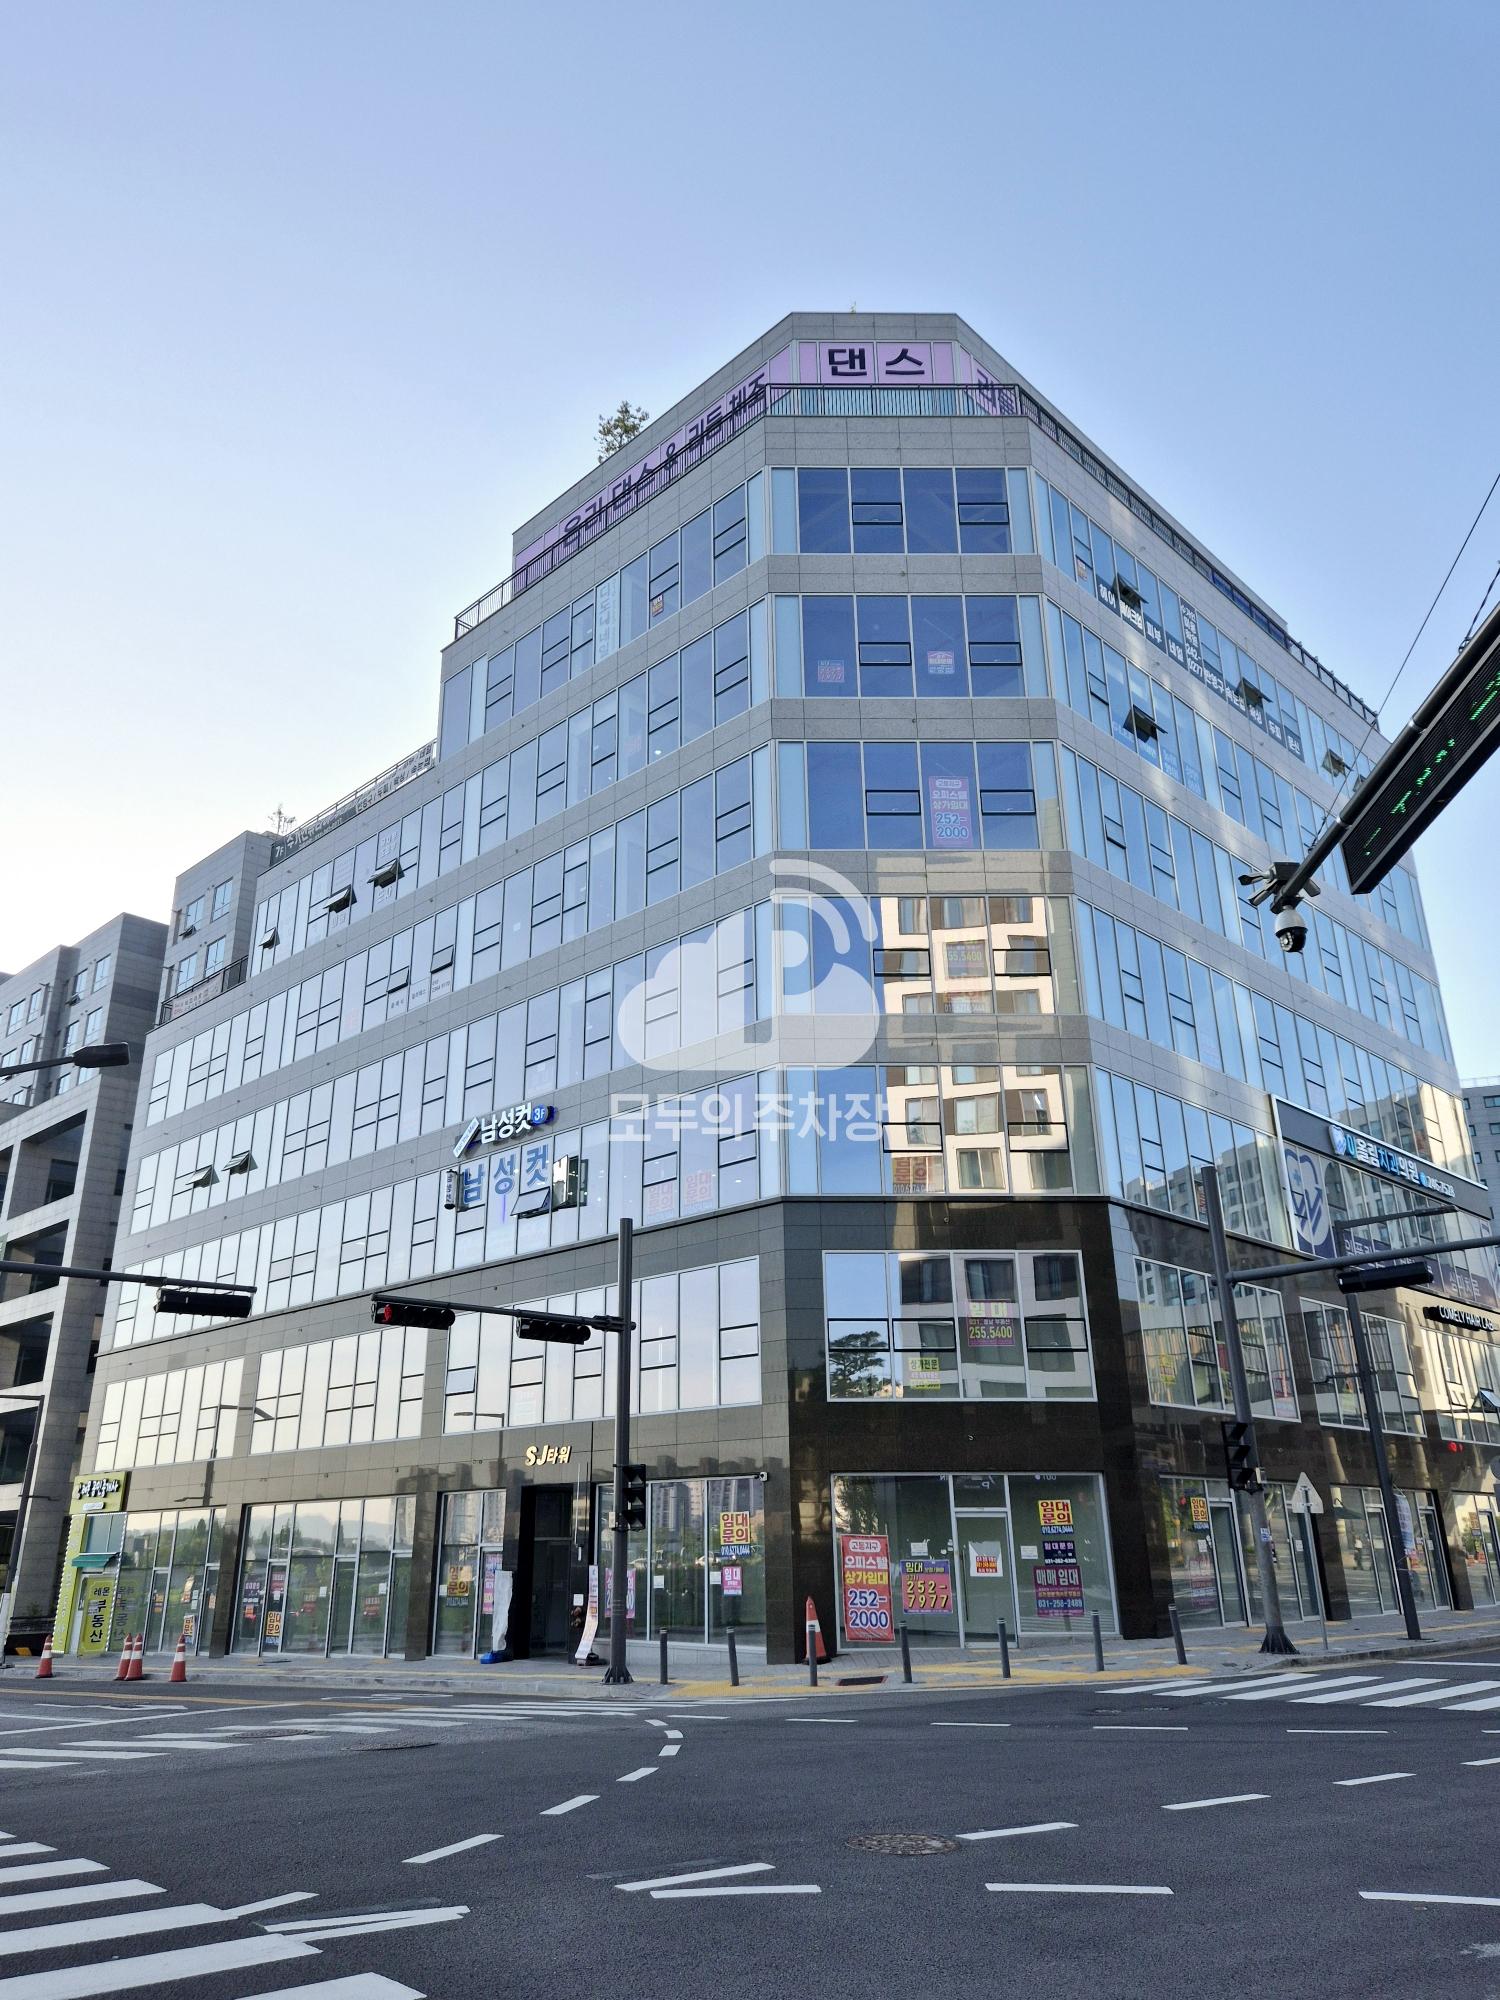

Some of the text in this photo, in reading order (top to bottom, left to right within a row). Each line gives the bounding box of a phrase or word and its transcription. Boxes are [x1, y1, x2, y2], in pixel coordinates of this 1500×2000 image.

[828, 347, 925, 377] 댄스
[1147, 621, 1162, 643] 피부
[936, 812, 967, 825] 252-
[936, 826, 968, 839] 2000
[481, 1102, 532, 1144] 남성컷
[534, 1107, 545, 1122] 3F
[463, 1144, 548, 1204] 남성컷
[969, 1302, 1008, 1318] 임대
[1439, 1305, 1495, 1331] COMELY HAIR LAB
[969, 1326, 1013, 1339] 255.5400
[526, 1445, 571, 1466] SJ타워
[1041, 1501, 1070, 1512] 임대
[722, 1512, 748, 1527] 임대
[1042, 1512, 1072, 1524] 문의
[722, 1528, 749, 1543] 문의
[845, 1555, 888, 1569] 오피스텔
[905, 1562, 923, 1573] 임대
[723, 1568, 740, 1580] 임대
[845, 1570, 889, 1586] 상가임대
[1036, 1568, 1079, 1585] 매매 임대
[93, 1587, 110, 1597] 레몬
[448, 1581, 469, 1594] 문의
[906, 1581, 947, 1594] 252-
[849, 1588, 887, 1608] 252-
[907, 1595, 949, 1609] 7977
[849, 1609, 890, 1629] 2000
